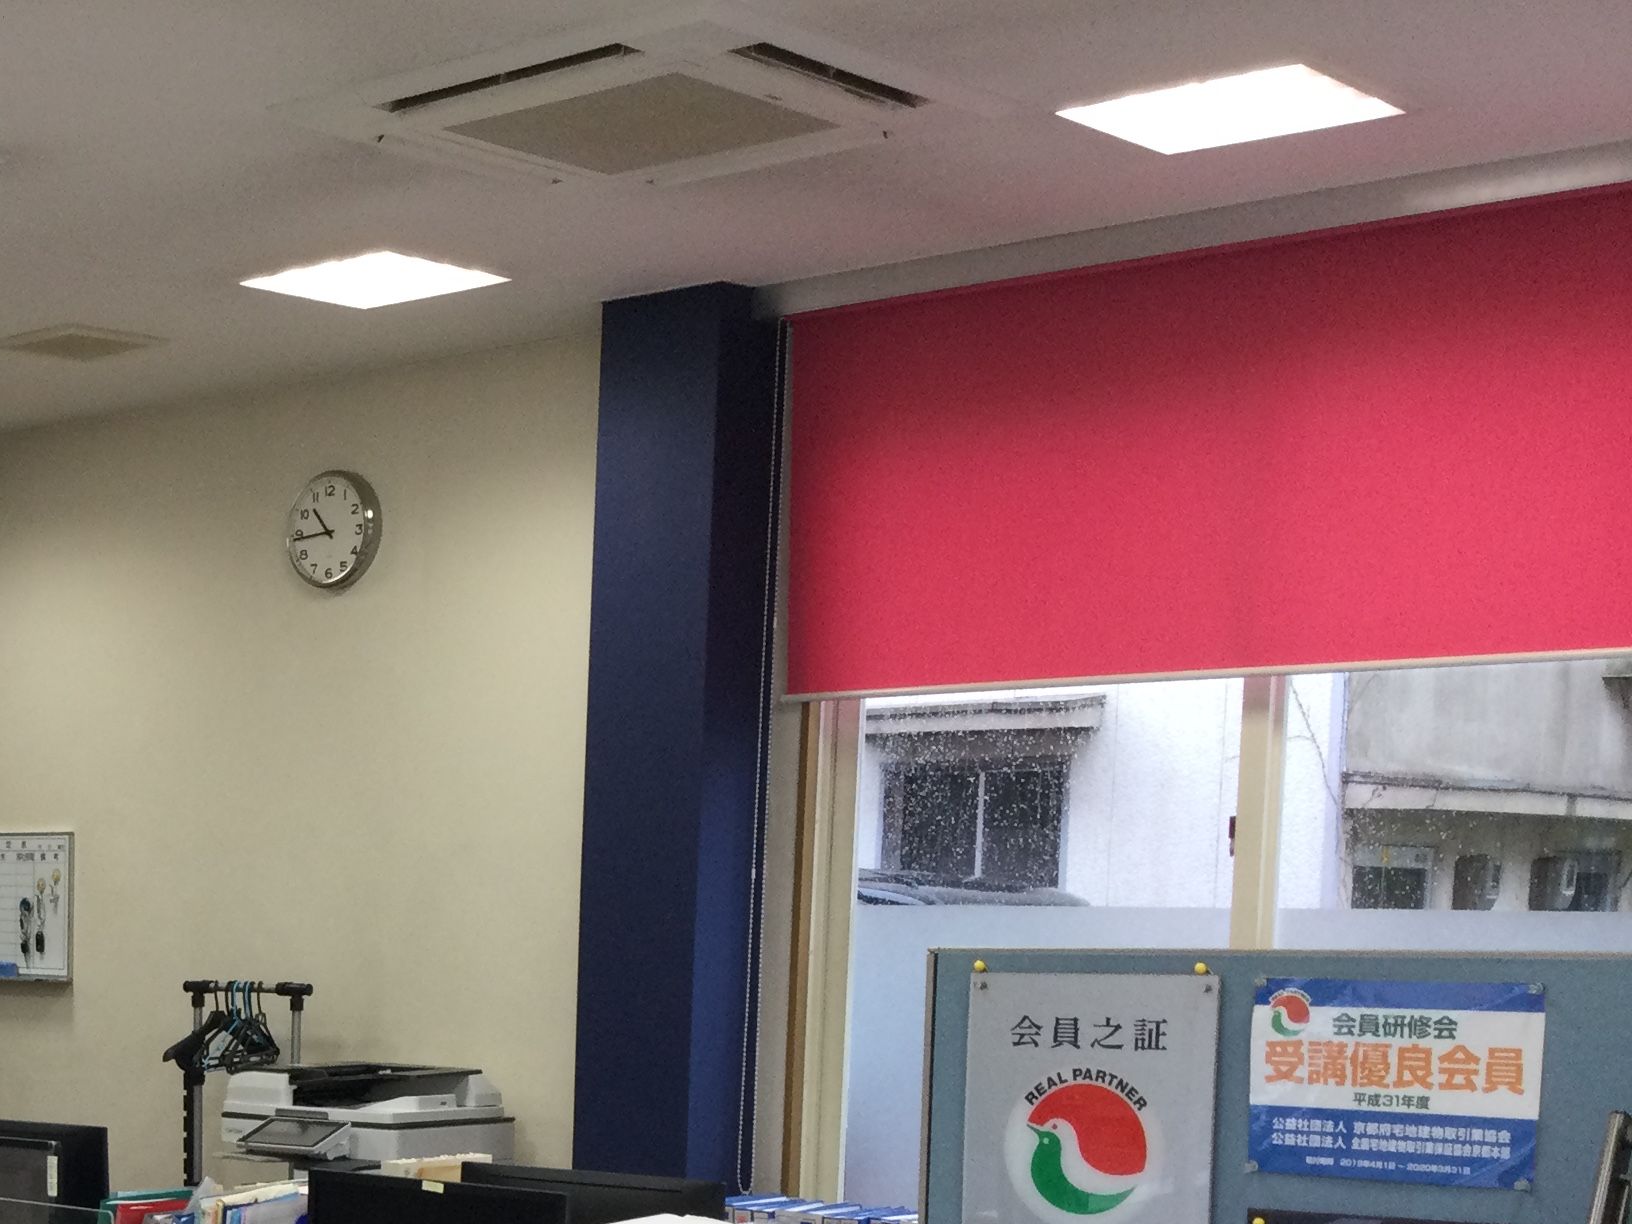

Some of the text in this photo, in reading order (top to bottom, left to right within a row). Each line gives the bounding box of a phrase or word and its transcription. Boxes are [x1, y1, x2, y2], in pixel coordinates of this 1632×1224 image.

[325, 485, 335, 497] 12
[344, 488, 347, 500] 1
[313, 492, 319, 503] 11
[300, 509, 309, 520] 10
[351, 504, 359, 514] 2
[355, 524, 363, 535] 3
[299, 549, 308, 560] 8
[350, 545, 358, 555] 4
[310, 563, 318, 574] 7
[339, 561, 348, 572] 5
[325, 568, 333, 579] 6
[1332, 1012, 1458, 1040] 会員研修会
[1009, 1014, 1168, 1052] 会員之証
[1264, 1039, 1525, 1096] 受講優良会員
[1024, 1067, 1148, 1111] REAL PARTNER
[1352, 1092, 1431, 1110] 平成31年度
[1272, 1117, 1347, 1134] 公益社団法人
[1271, 1132, 1347, 1150] 公益社団法人
